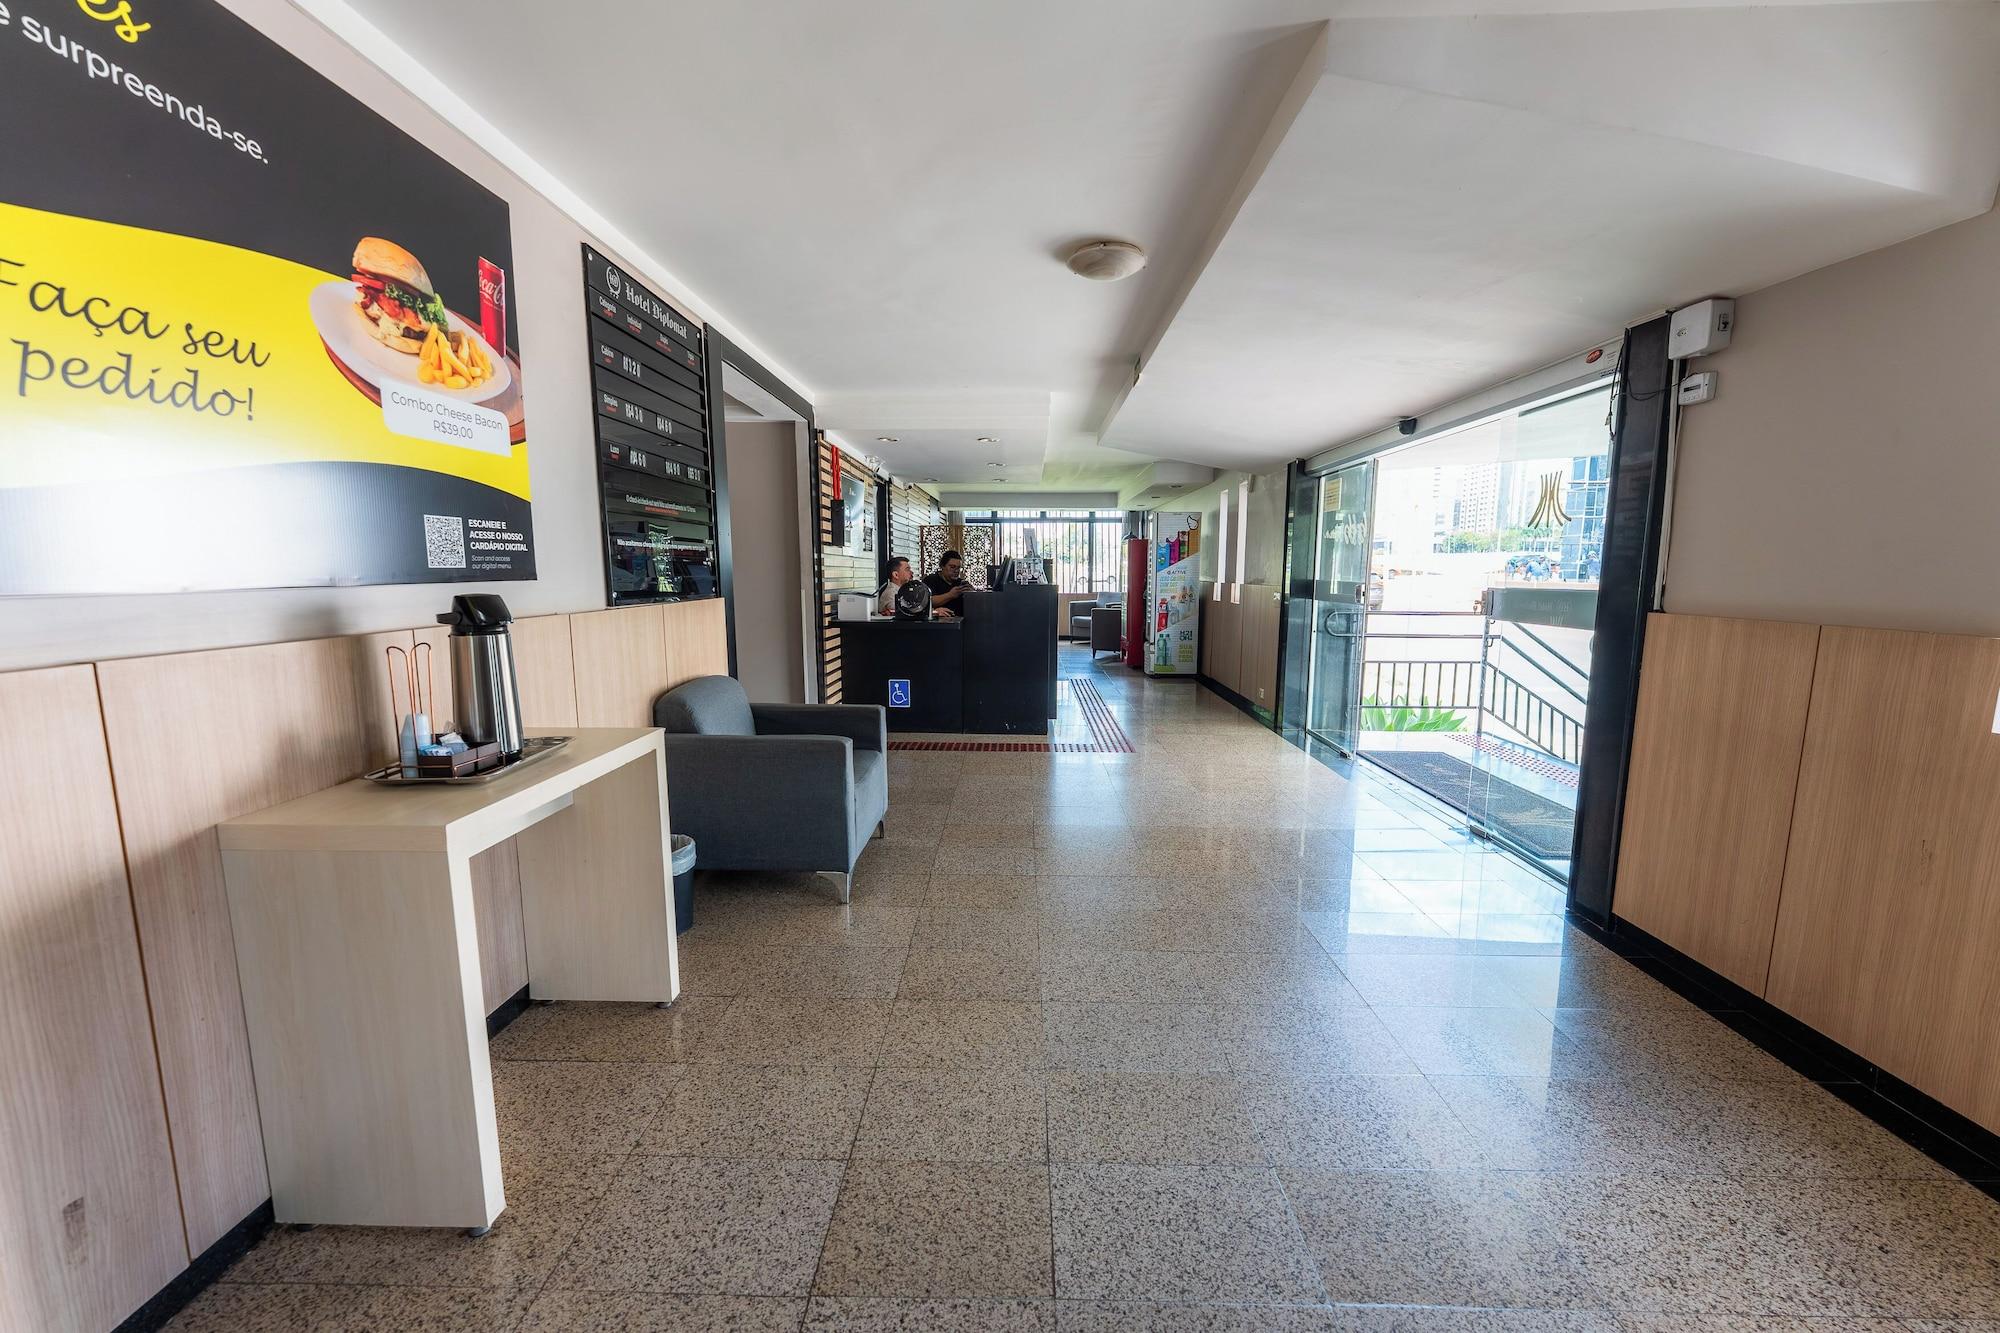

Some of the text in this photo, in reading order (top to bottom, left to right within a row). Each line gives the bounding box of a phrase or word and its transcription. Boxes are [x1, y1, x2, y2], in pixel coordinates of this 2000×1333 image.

[21, 15, 268, 164] surpreenda-se.
[625, 282, 688, 339] Hotel Diplomat
[182, 323, 271, 367] seu
[10, 338, 254, 421] pedido!
[391, 391, 503, 431] Combo Cheese Bacon
[433, 420, 474, 439] R$39,00
[468, 519, 507, 530] ESCANEIE E
[469, 530, 524, 541] ACESSE O NOSSO
[470, 541, 529, 552] CARDÁPIO DIGITAL
